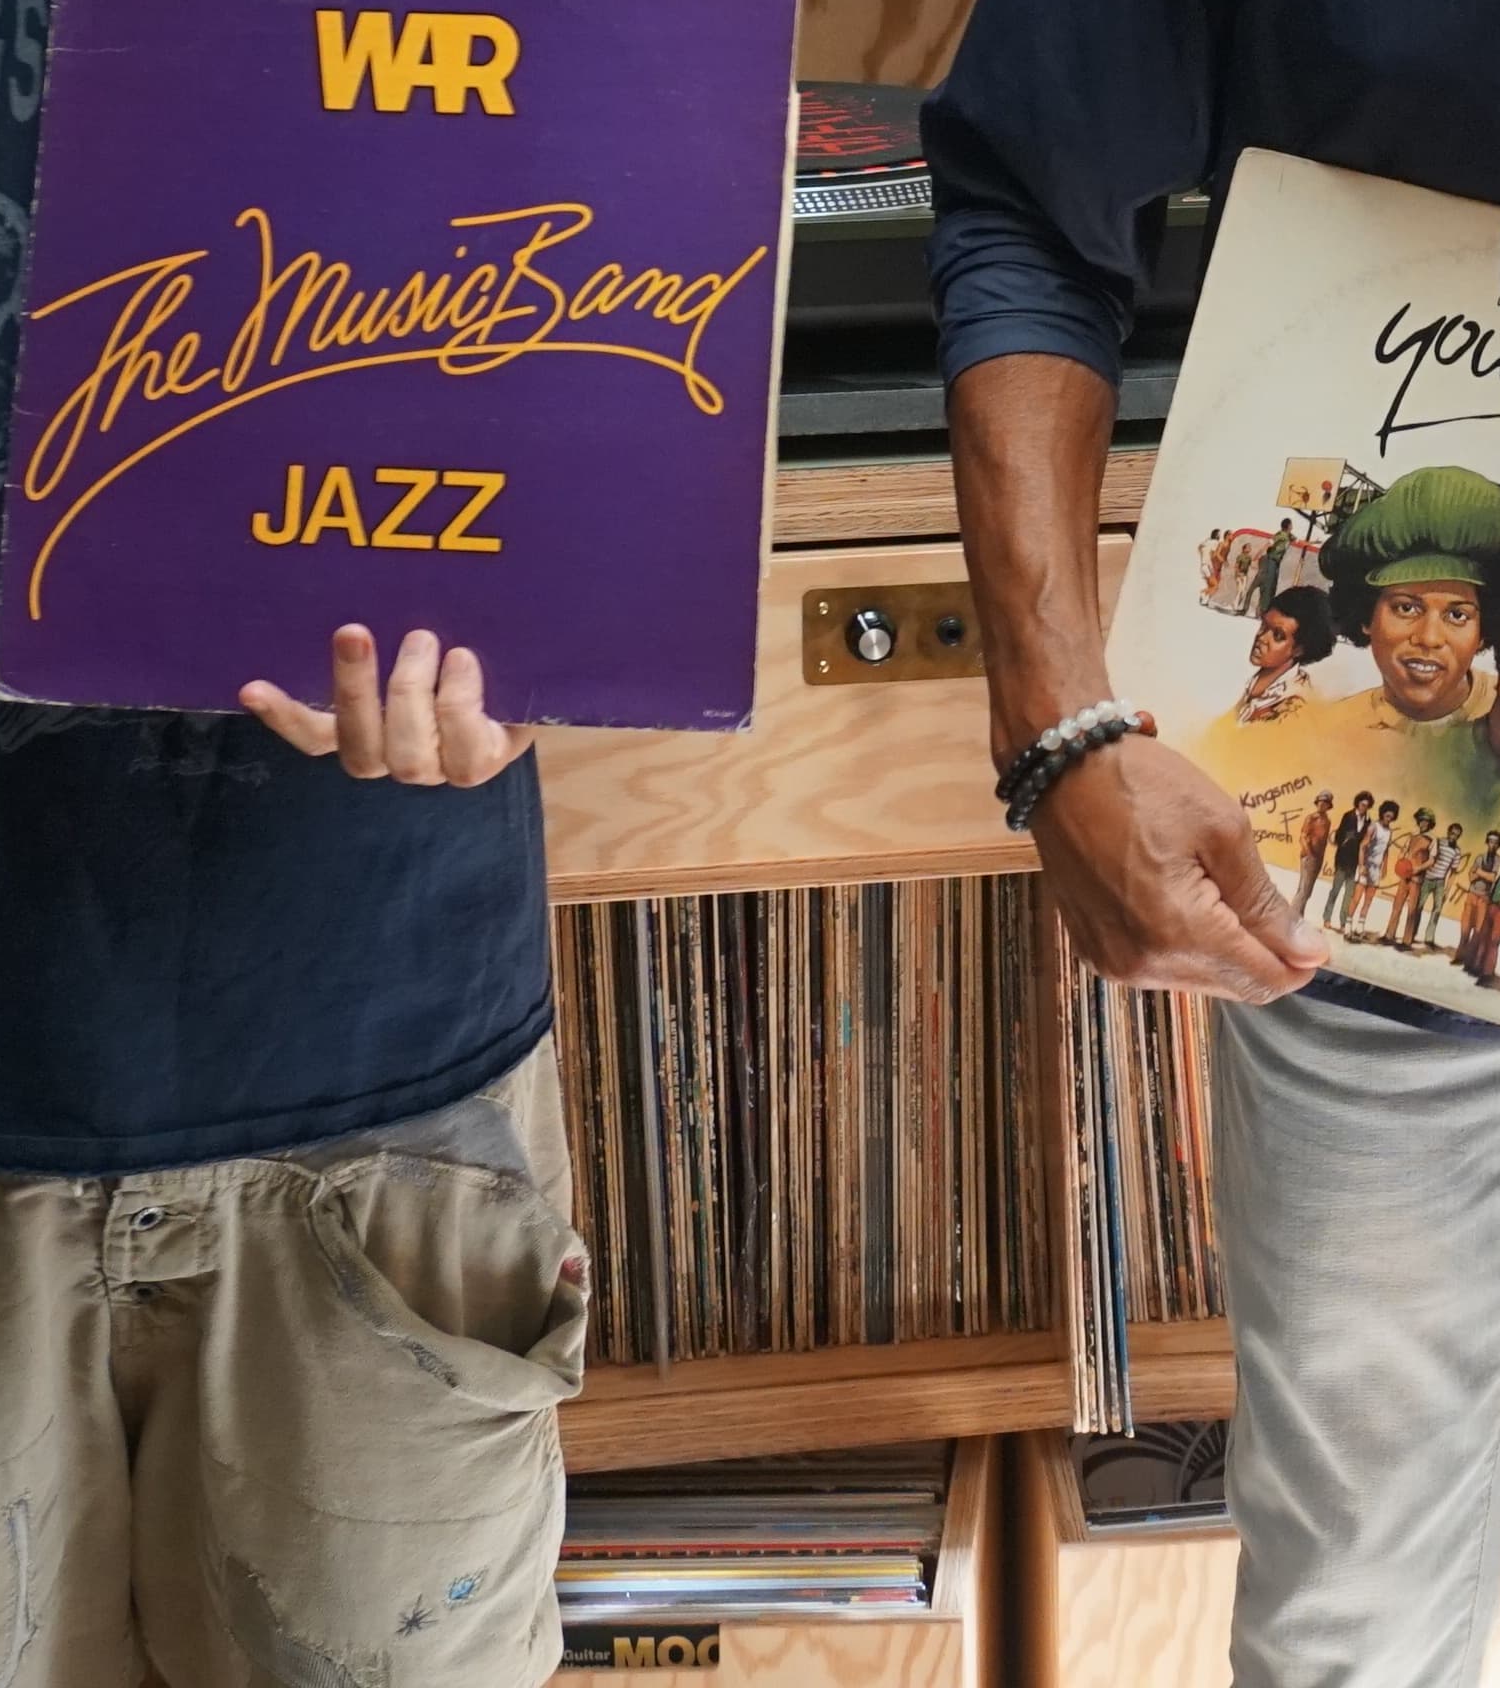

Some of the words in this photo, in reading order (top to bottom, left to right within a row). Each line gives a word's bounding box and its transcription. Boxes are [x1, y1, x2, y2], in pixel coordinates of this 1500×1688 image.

[316, 9, 521, 116] WAR
[251, 465, 507, 553] JAZZ
[1239, 773, 1312, 814] Kingsmen
[564, 1648, 611, 1661] Guitar
